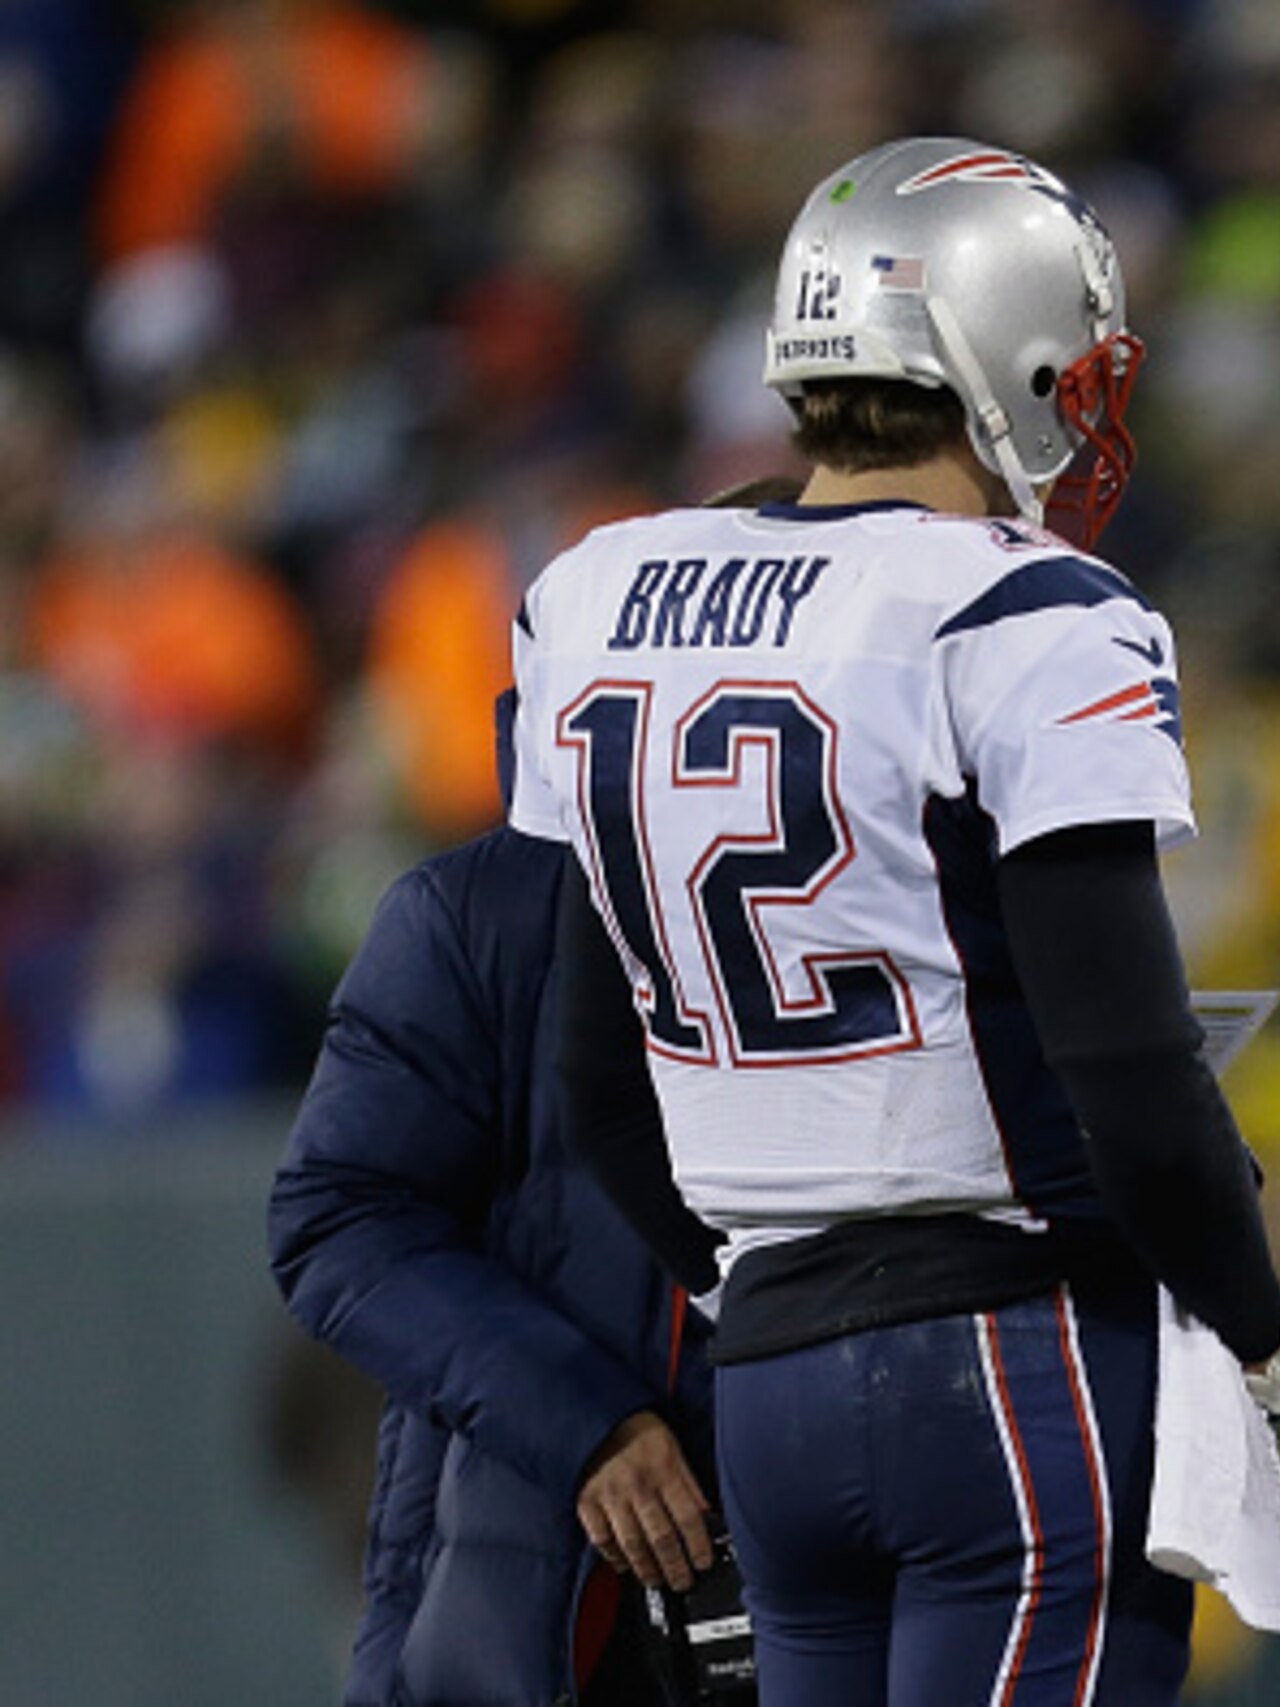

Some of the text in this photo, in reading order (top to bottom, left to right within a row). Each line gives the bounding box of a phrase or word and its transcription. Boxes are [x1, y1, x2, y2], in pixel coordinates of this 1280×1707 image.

[796, 270, 842, 320] 12
[608, 556, 831, 651] BRADY
[556, 679, 923, 1068] 12
